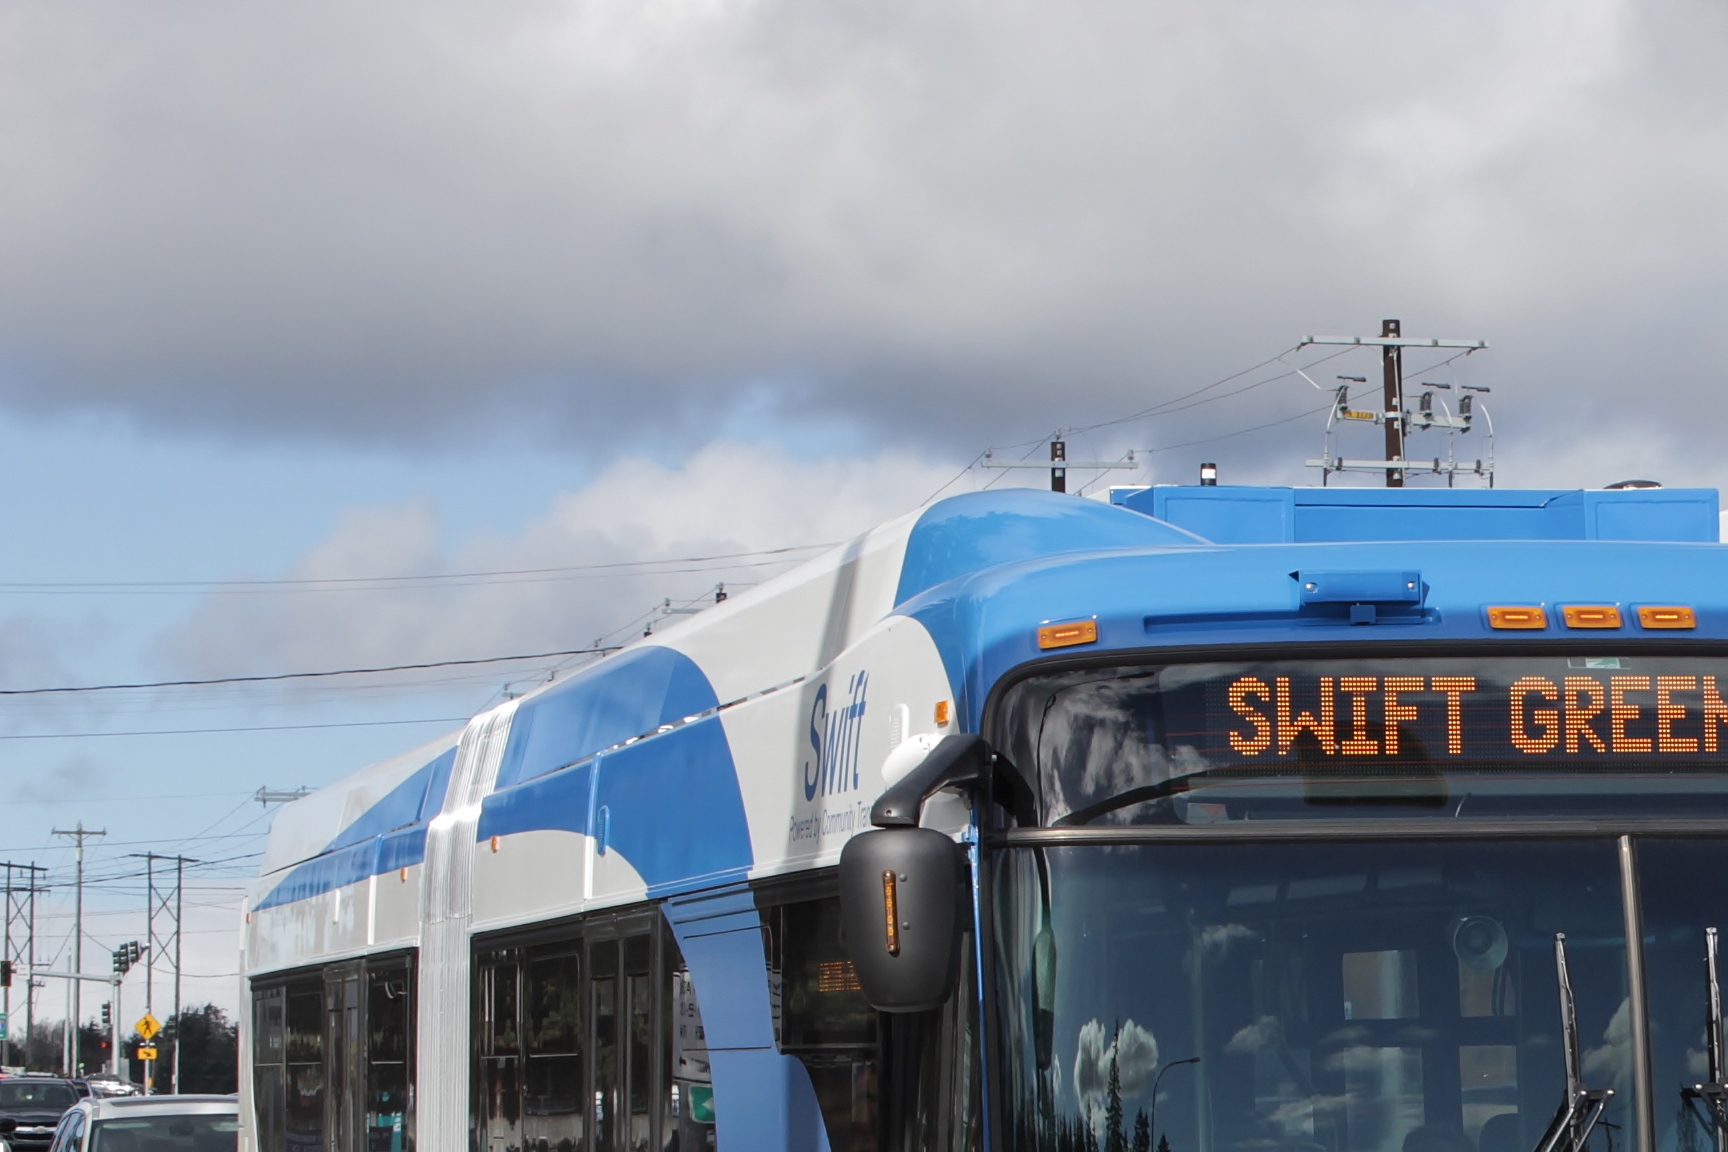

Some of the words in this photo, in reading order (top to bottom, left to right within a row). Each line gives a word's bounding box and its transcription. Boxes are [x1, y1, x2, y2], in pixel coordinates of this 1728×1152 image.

[804, 669, 870, 802] Swift
[1229, 675, 1476, 756] SWIFT
[789, 811, 813, 842] Powered
[821, 803, 857, 838] Community
[857, 800, 872, 829] Tran
